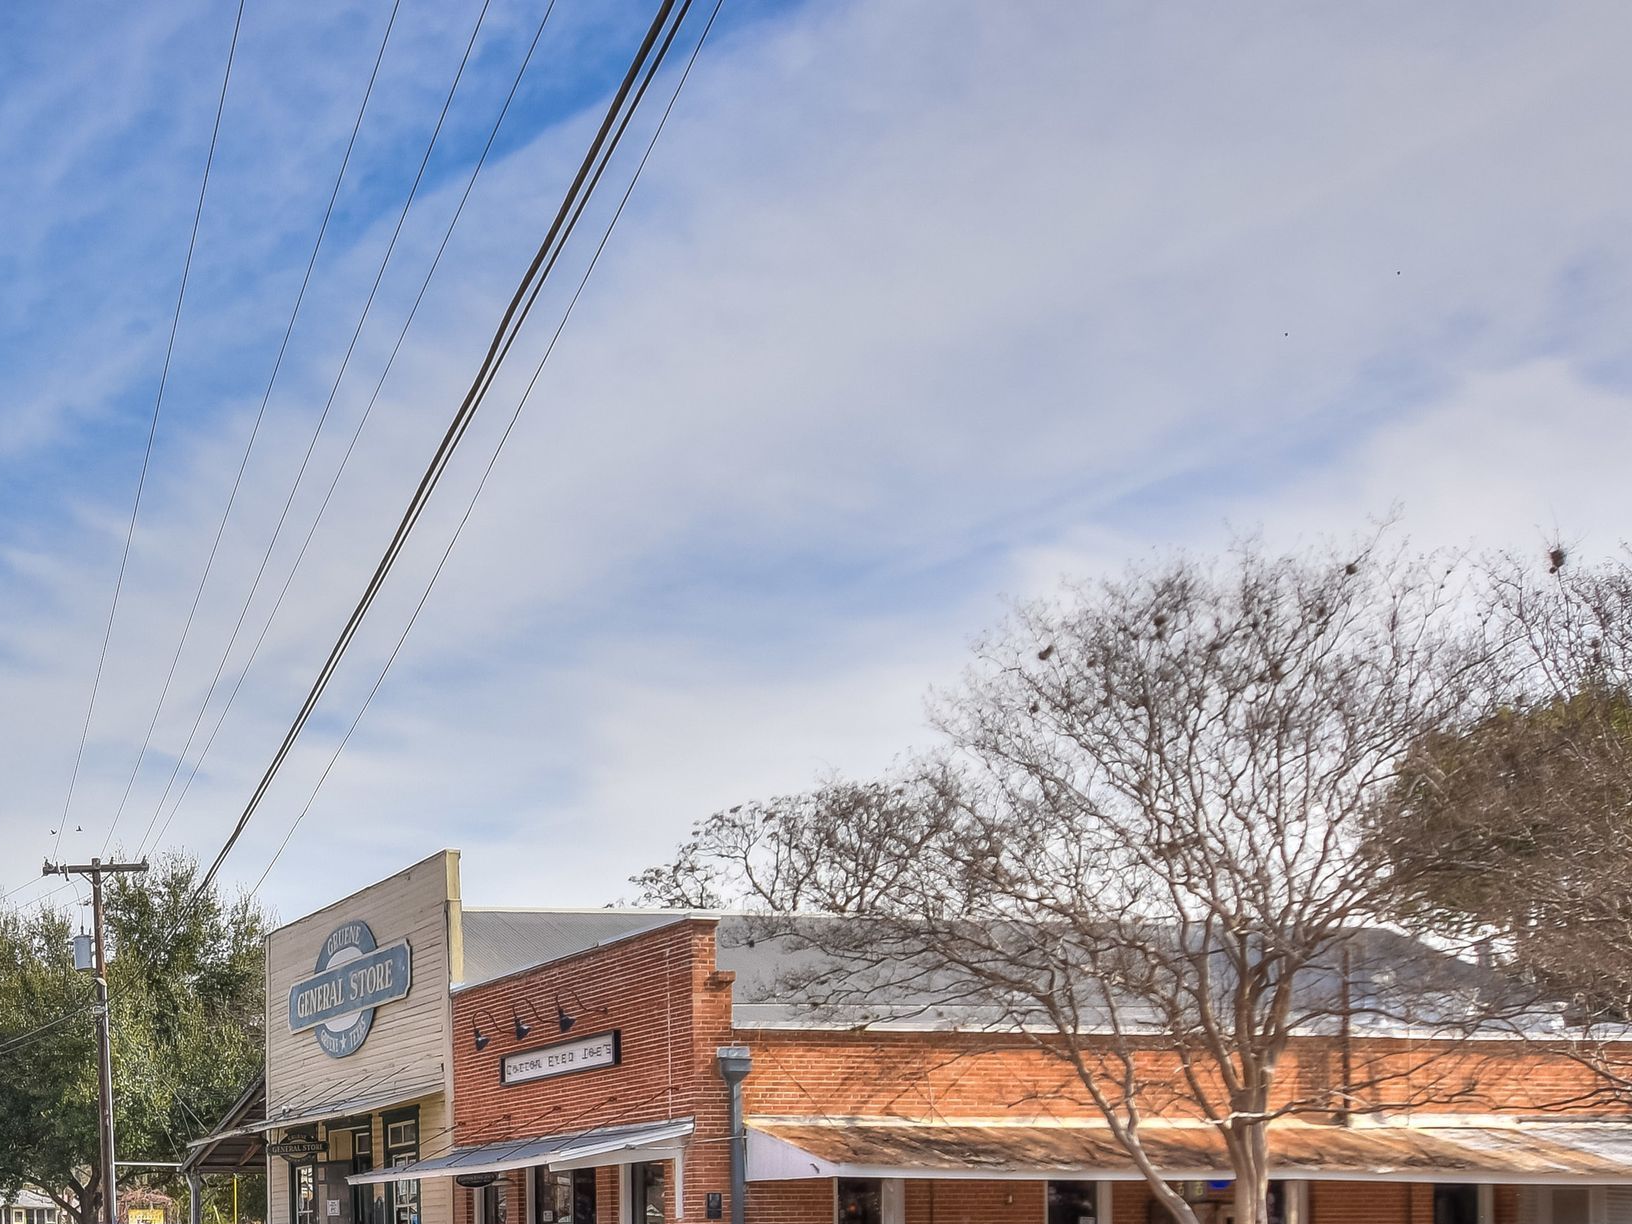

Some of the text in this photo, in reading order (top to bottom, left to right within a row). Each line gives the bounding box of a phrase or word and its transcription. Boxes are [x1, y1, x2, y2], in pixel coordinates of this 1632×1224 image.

[327, 926, 361, 956] GRUENE
[297, 959, 394, 1018] GENERAL STORE
[349, 1016, 366, 1046] TEXAS
[272, 1144, 322, 1153] GENERAL STORE
